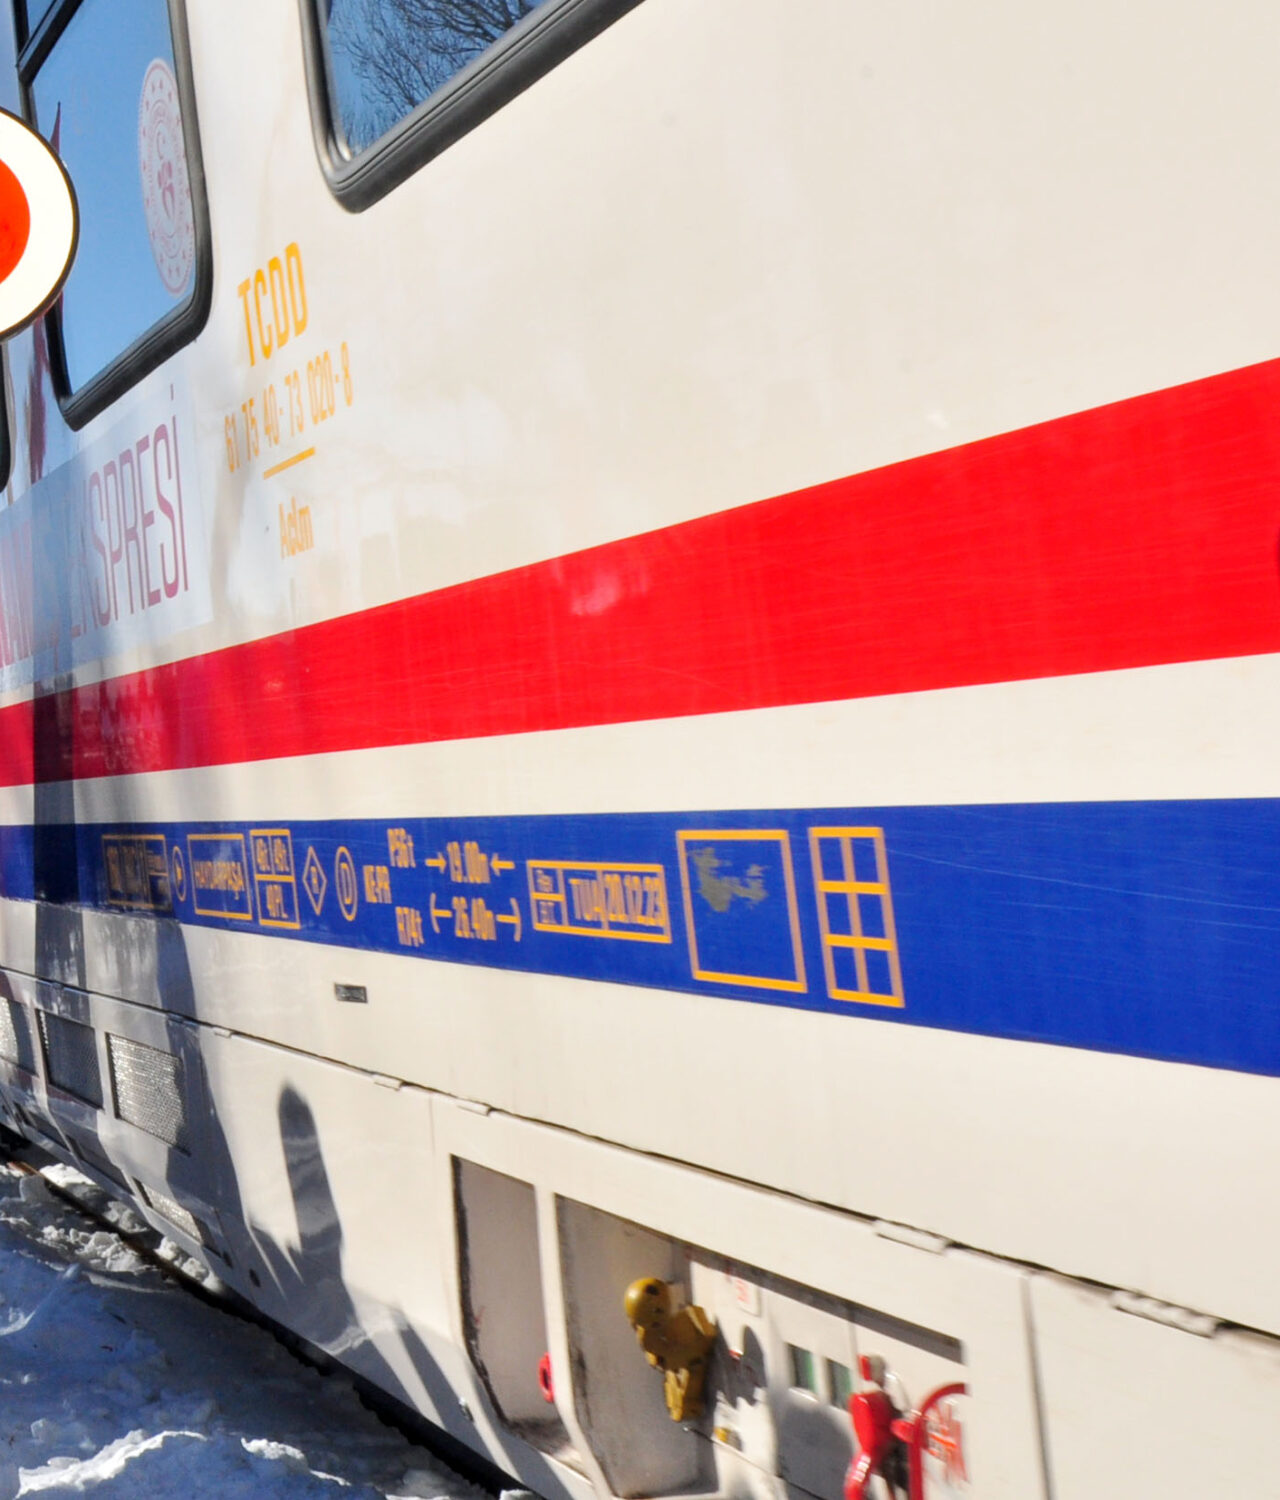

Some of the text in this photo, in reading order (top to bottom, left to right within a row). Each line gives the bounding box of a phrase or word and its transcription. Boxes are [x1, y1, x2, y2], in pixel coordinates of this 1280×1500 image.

[237, 242, 309, 366] TCDD
[224, 412, 240, 473] 61
[241, 397, 260, 461] 75
[340, 862, 353, 904] D
